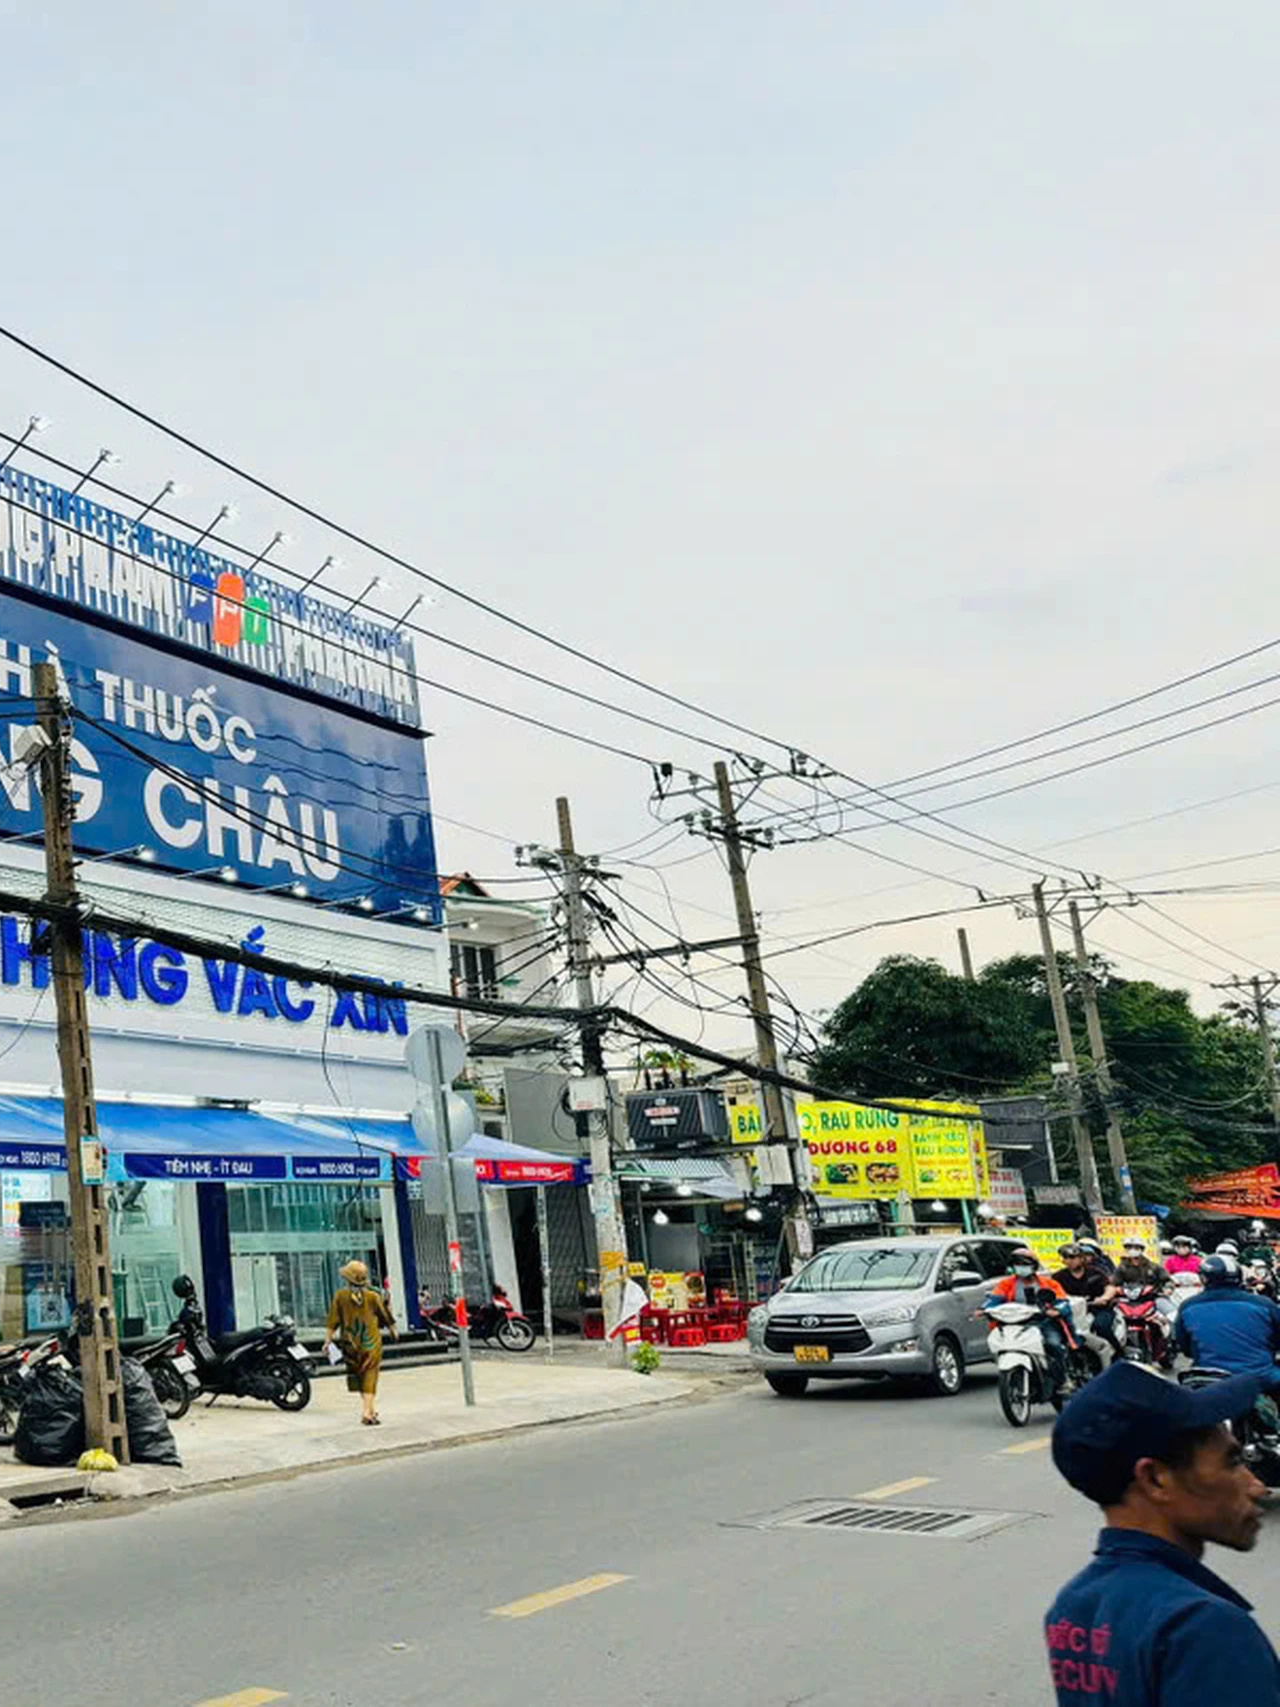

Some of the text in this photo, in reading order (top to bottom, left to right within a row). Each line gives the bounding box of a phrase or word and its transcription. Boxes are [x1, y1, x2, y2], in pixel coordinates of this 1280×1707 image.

[95, 669, 257, 764] THUỐC
[144, 765, 340, 882] CHÂU
[330, 973, 409, 1036] XIN
[820, 1111, 851, 1131] RAU
[875, 1138, 897, 1154] 68
